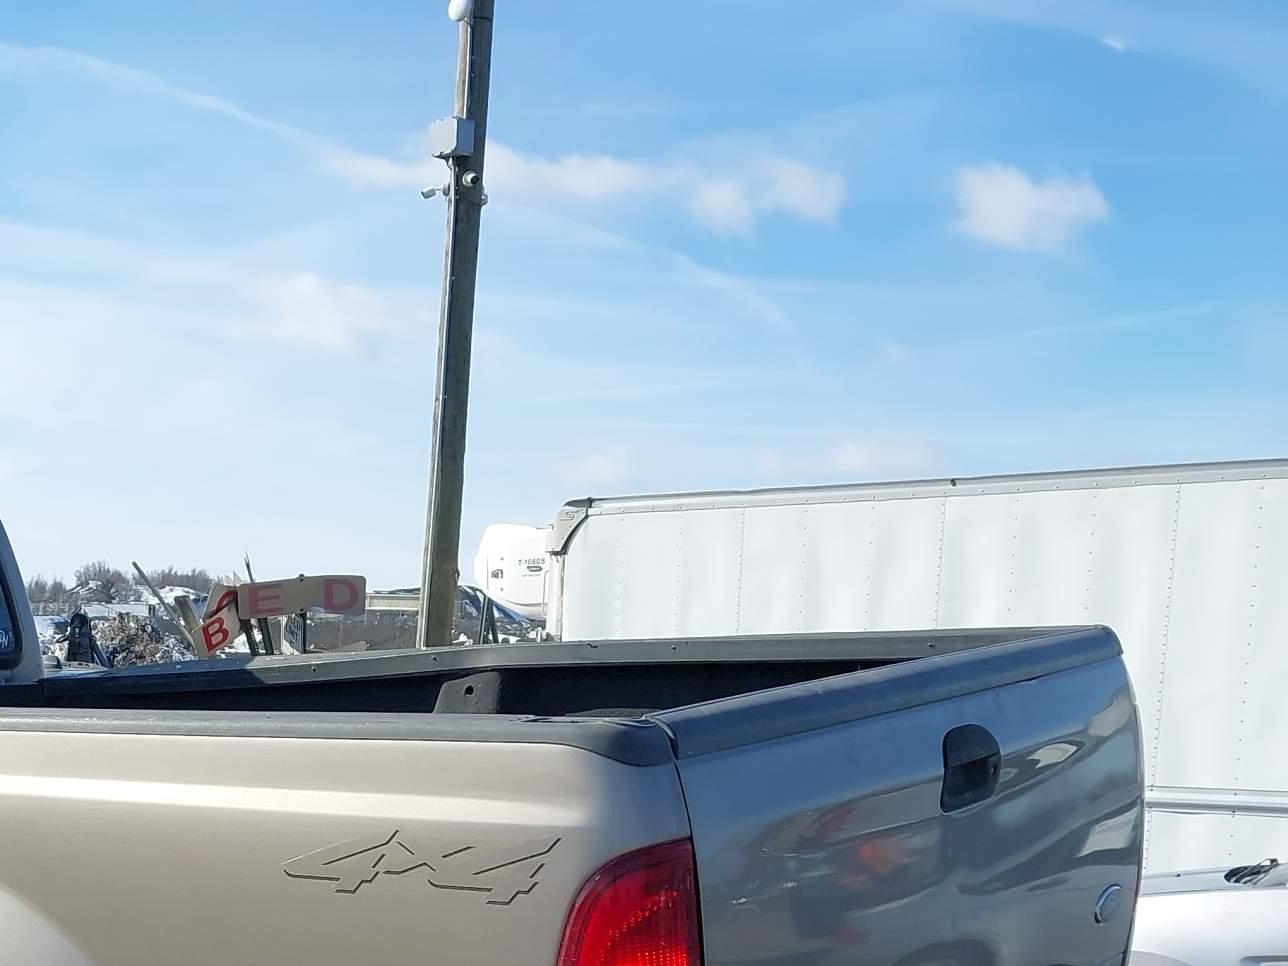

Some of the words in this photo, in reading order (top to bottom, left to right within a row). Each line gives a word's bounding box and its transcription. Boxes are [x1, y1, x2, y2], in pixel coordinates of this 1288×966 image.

[247, 583, 283, 615] E
[324, 578, 358, 614] D
[201, 617, 230, 653] B
